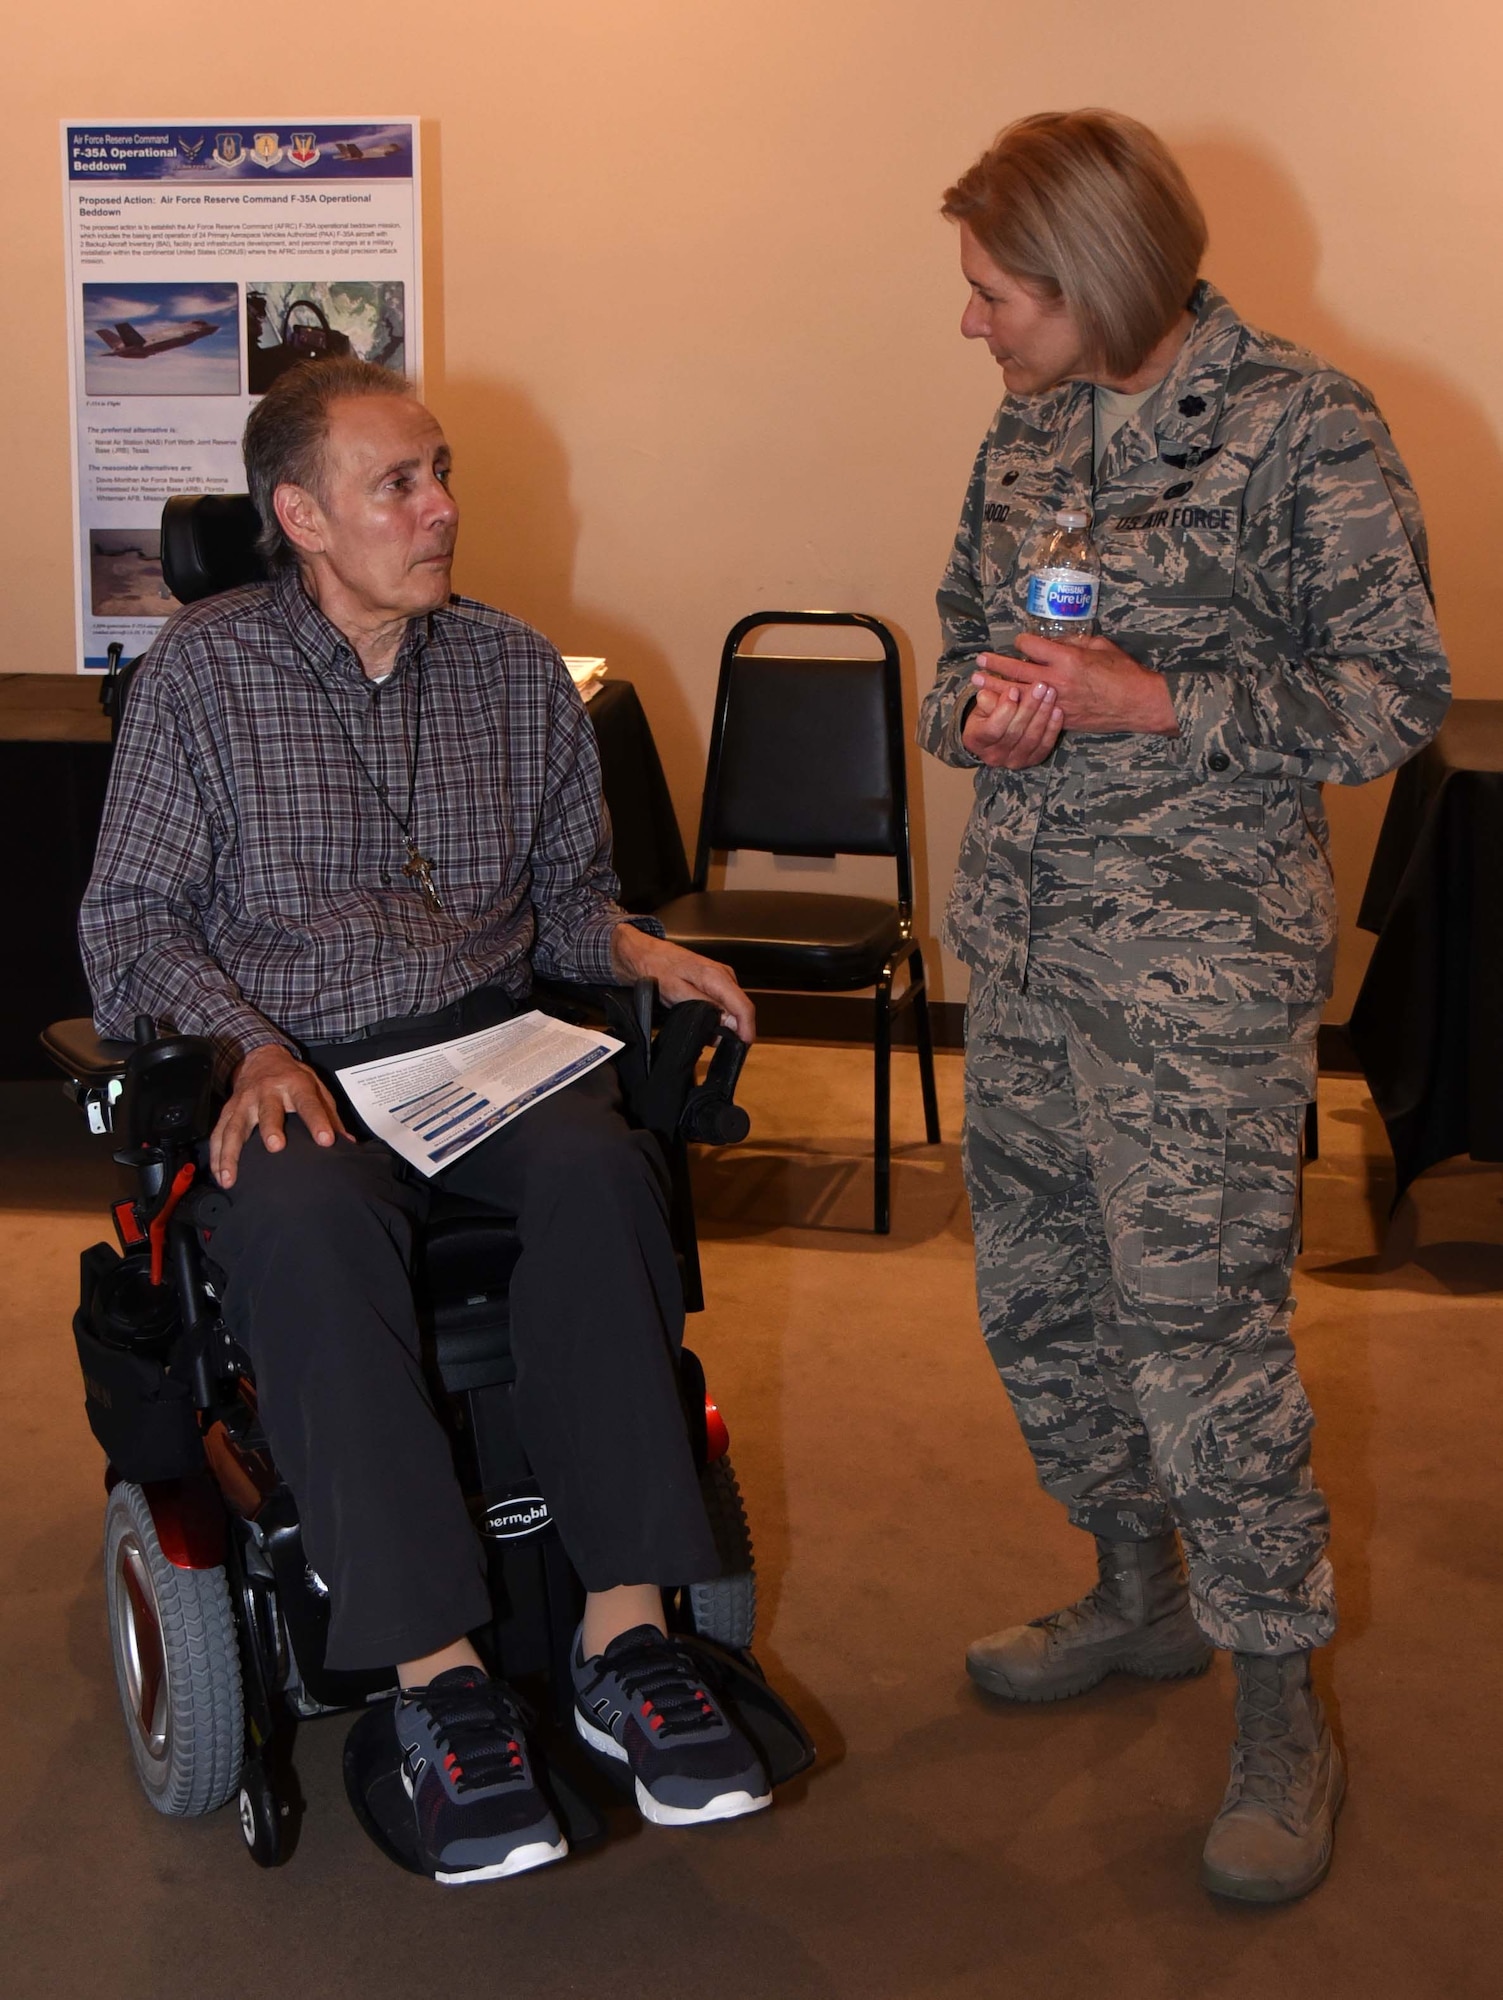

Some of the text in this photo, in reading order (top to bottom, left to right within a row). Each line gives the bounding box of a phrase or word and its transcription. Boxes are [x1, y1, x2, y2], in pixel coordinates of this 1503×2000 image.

[74, 134, 169, 145] Air Force Reserve Command
[73, 148, 177, 159] F-35A Operational
[73, 161, 126, 171] Beddown
[79, 194, 371, 206] Proposed Action: Air Force Reserve Command F-35A Operational
[79, 208, 121, 216] Beddown
[1142, 510, 1169, 529] AIR
[1171, 507, 1230, 530] FORCE
[1049, 592, 1091, 607] Pure Life
[486, 1504, 547, 1531] permobil
